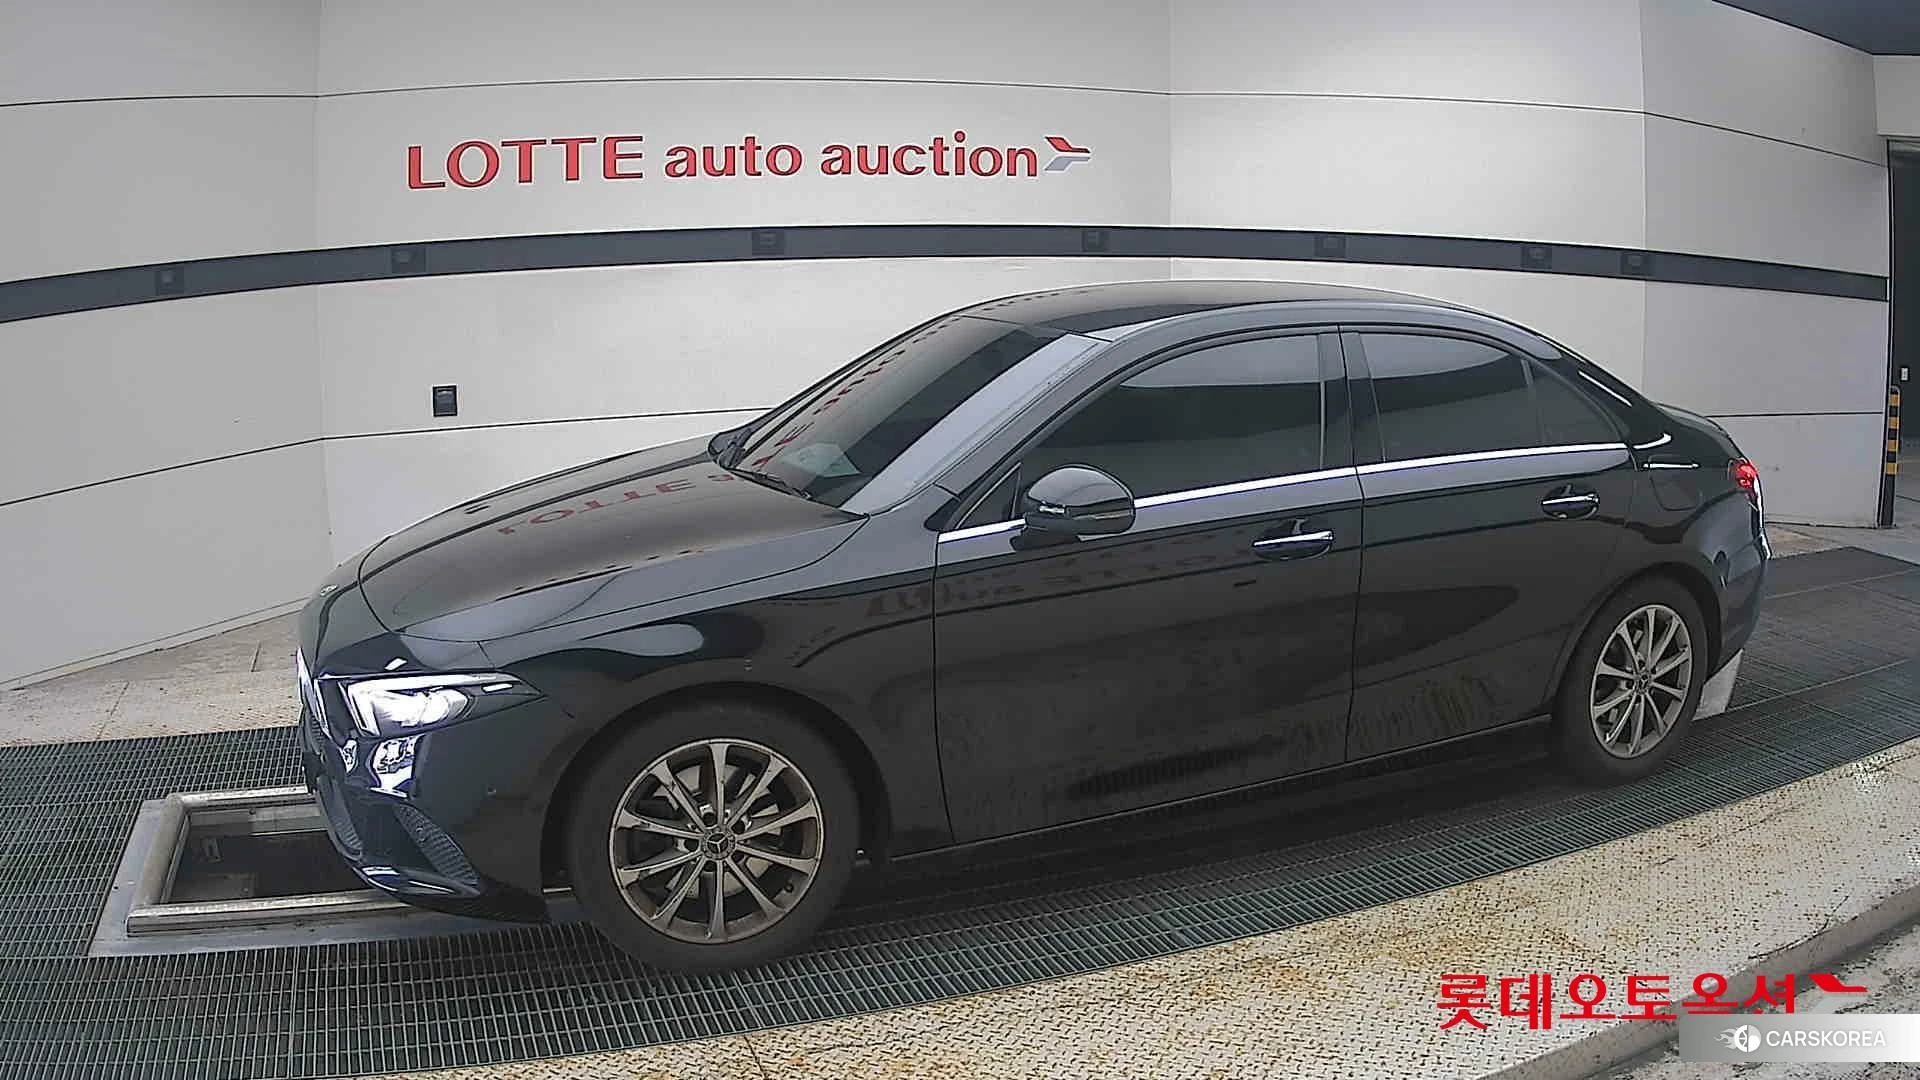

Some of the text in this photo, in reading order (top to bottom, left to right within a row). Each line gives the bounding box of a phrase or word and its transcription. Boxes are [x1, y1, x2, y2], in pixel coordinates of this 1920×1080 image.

[407, 131, 1037, 190] LOTTE auto auction
